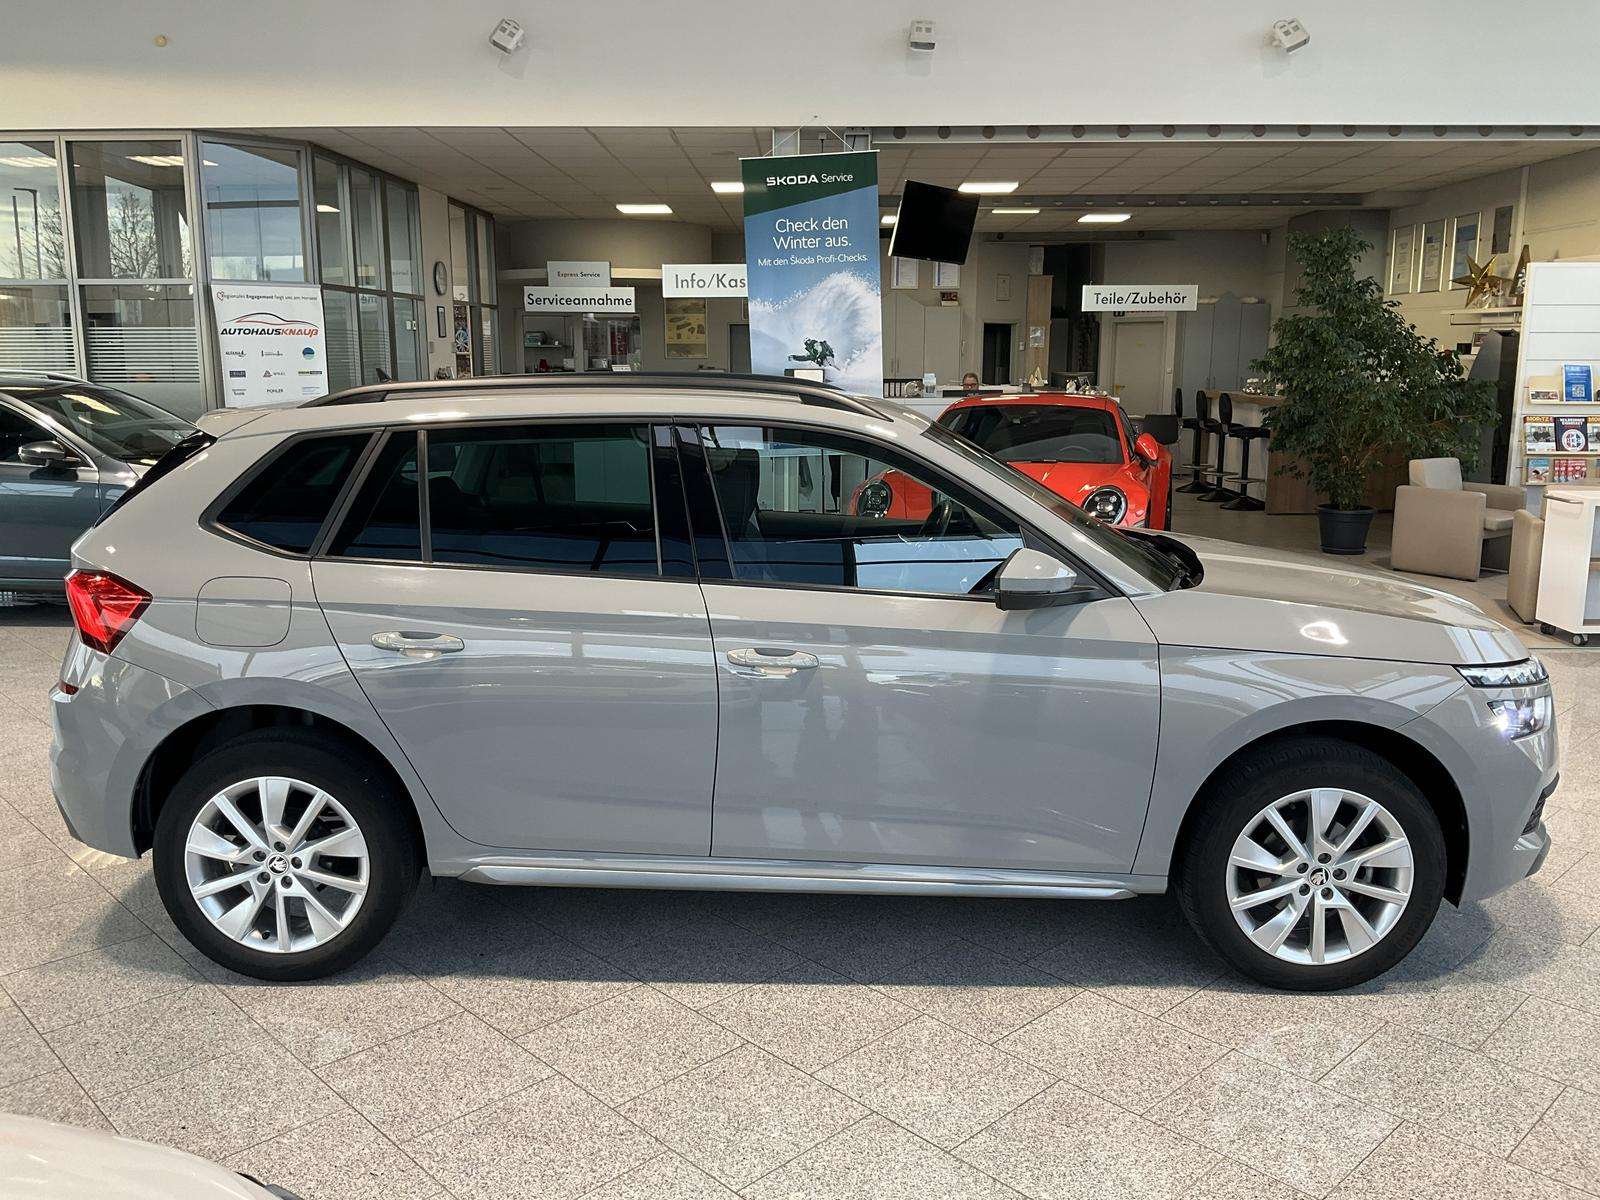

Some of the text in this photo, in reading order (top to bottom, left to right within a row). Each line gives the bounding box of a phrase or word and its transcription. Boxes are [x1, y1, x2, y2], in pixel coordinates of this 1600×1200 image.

[821, 173, 854, 184] Service
[775, 216, 848, 233] Check den
[772, 236, 852, 250] Winter aus.
[757, 258, 773, 267] Mit
[773, 257, 788, 266] den
[557, 270, 579, 279] Express
[527, 293, 633, 306] Serviceannahme
[1093, 291, 1187, 305] Teile/Zubehör
